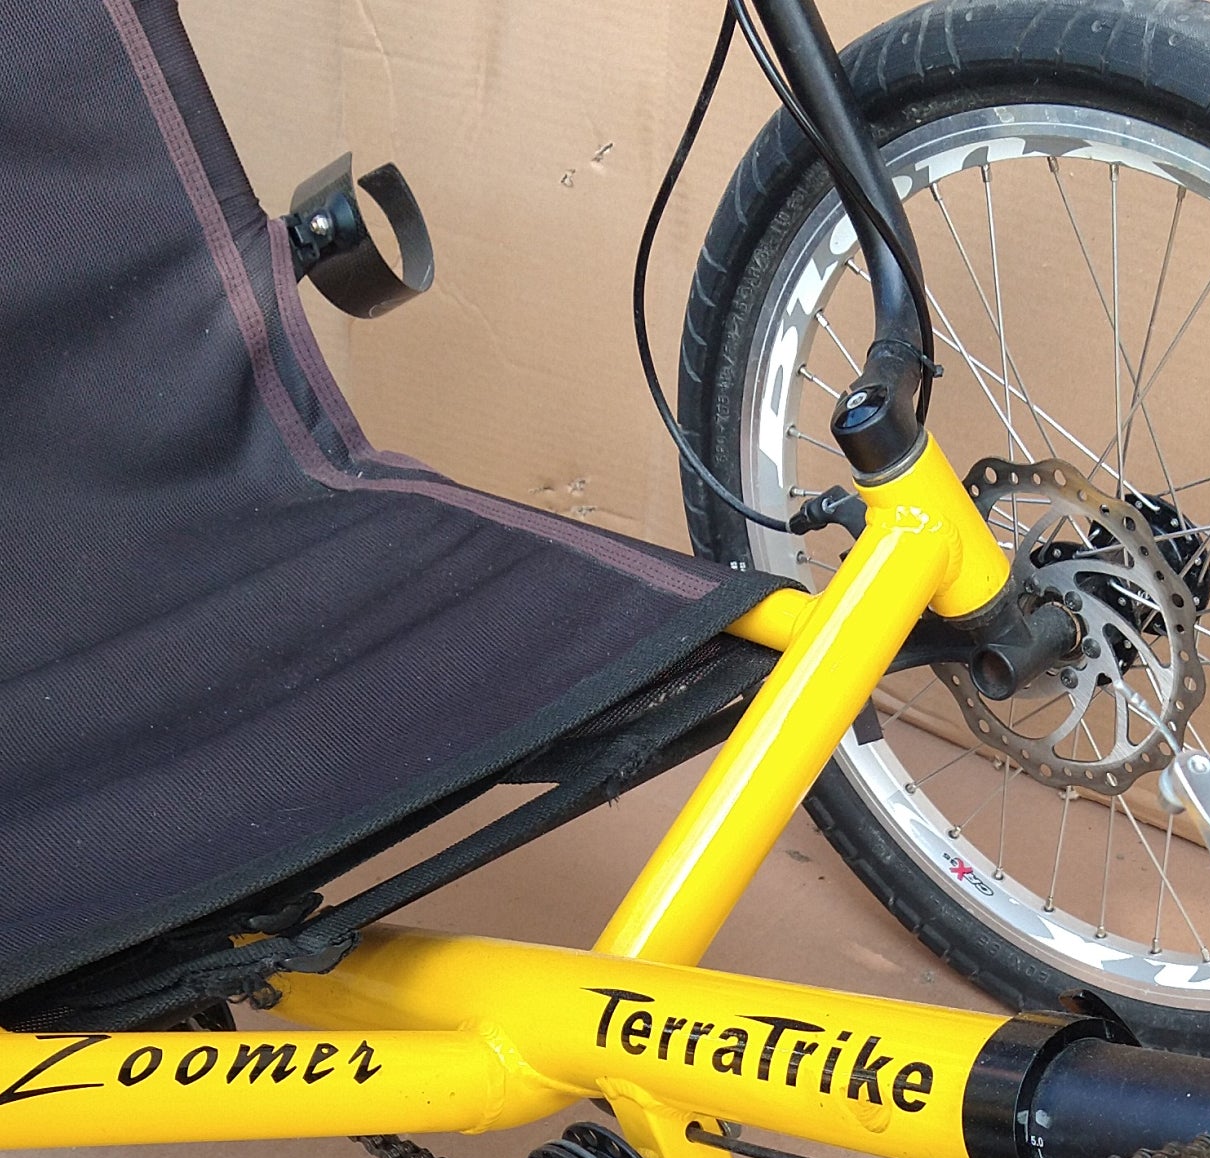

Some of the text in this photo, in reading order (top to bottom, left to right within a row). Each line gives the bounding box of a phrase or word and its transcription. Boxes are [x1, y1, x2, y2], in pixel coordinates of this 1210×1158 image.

[0, 1034, 382, 1105] Zoomer
[580, 987, 934, 1113] TerraTrike
[1030, 1135, 1043, 1147] 5.0
